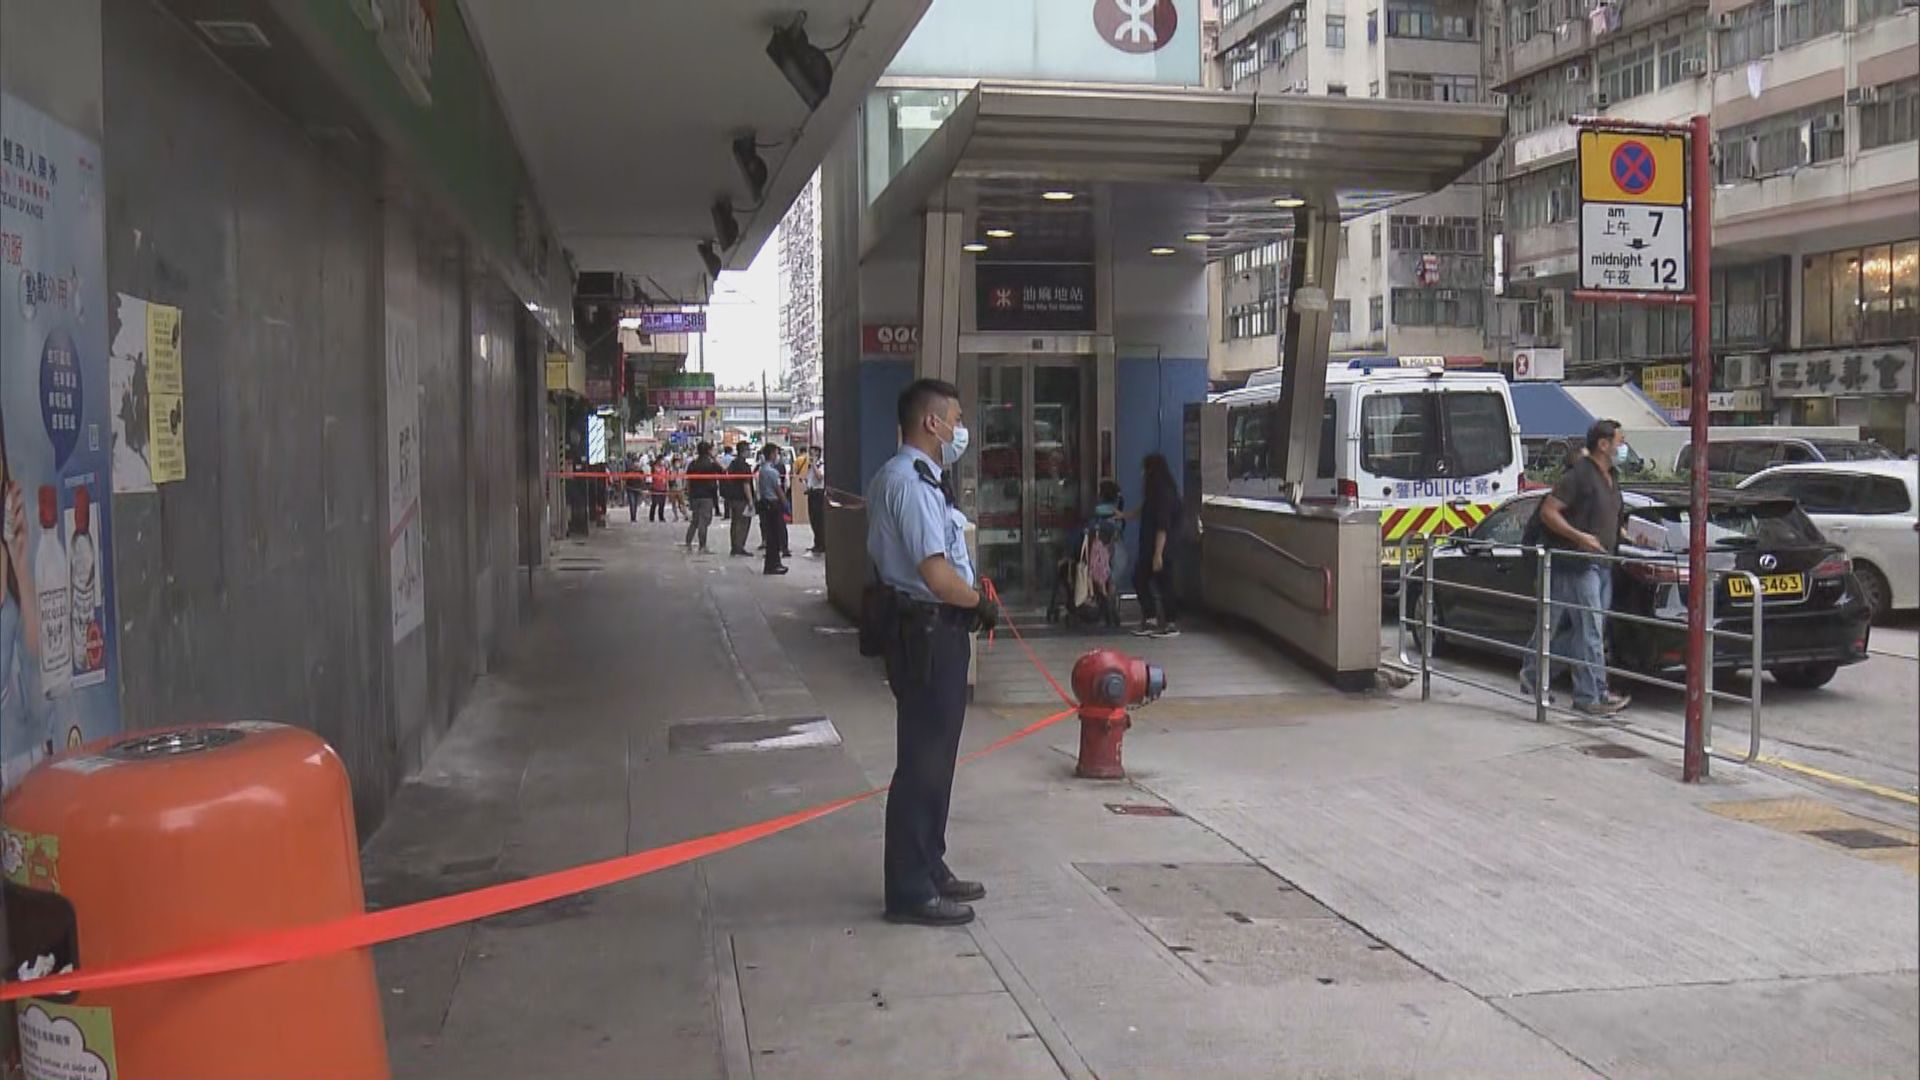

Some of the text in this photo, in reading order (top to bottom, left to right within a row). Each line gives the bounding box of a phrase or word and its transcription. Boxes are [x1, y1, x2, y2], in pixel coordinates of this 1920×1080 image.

[1607, 207, 1625, 218] am
[1602, 220, 1631, 237] 上午
[1648, 211, 1664, 237] 7
[1591, 252, 1642, 269] midnight
[1603, 270, 1631, 286] 午夜
[1650, 258, 1678, 284] 12
[1023, 285, 1083, 301] 油麻地站
[1413, 478, 1472, 497] POLICE
[1760, 576, 1799, 592] 5463
